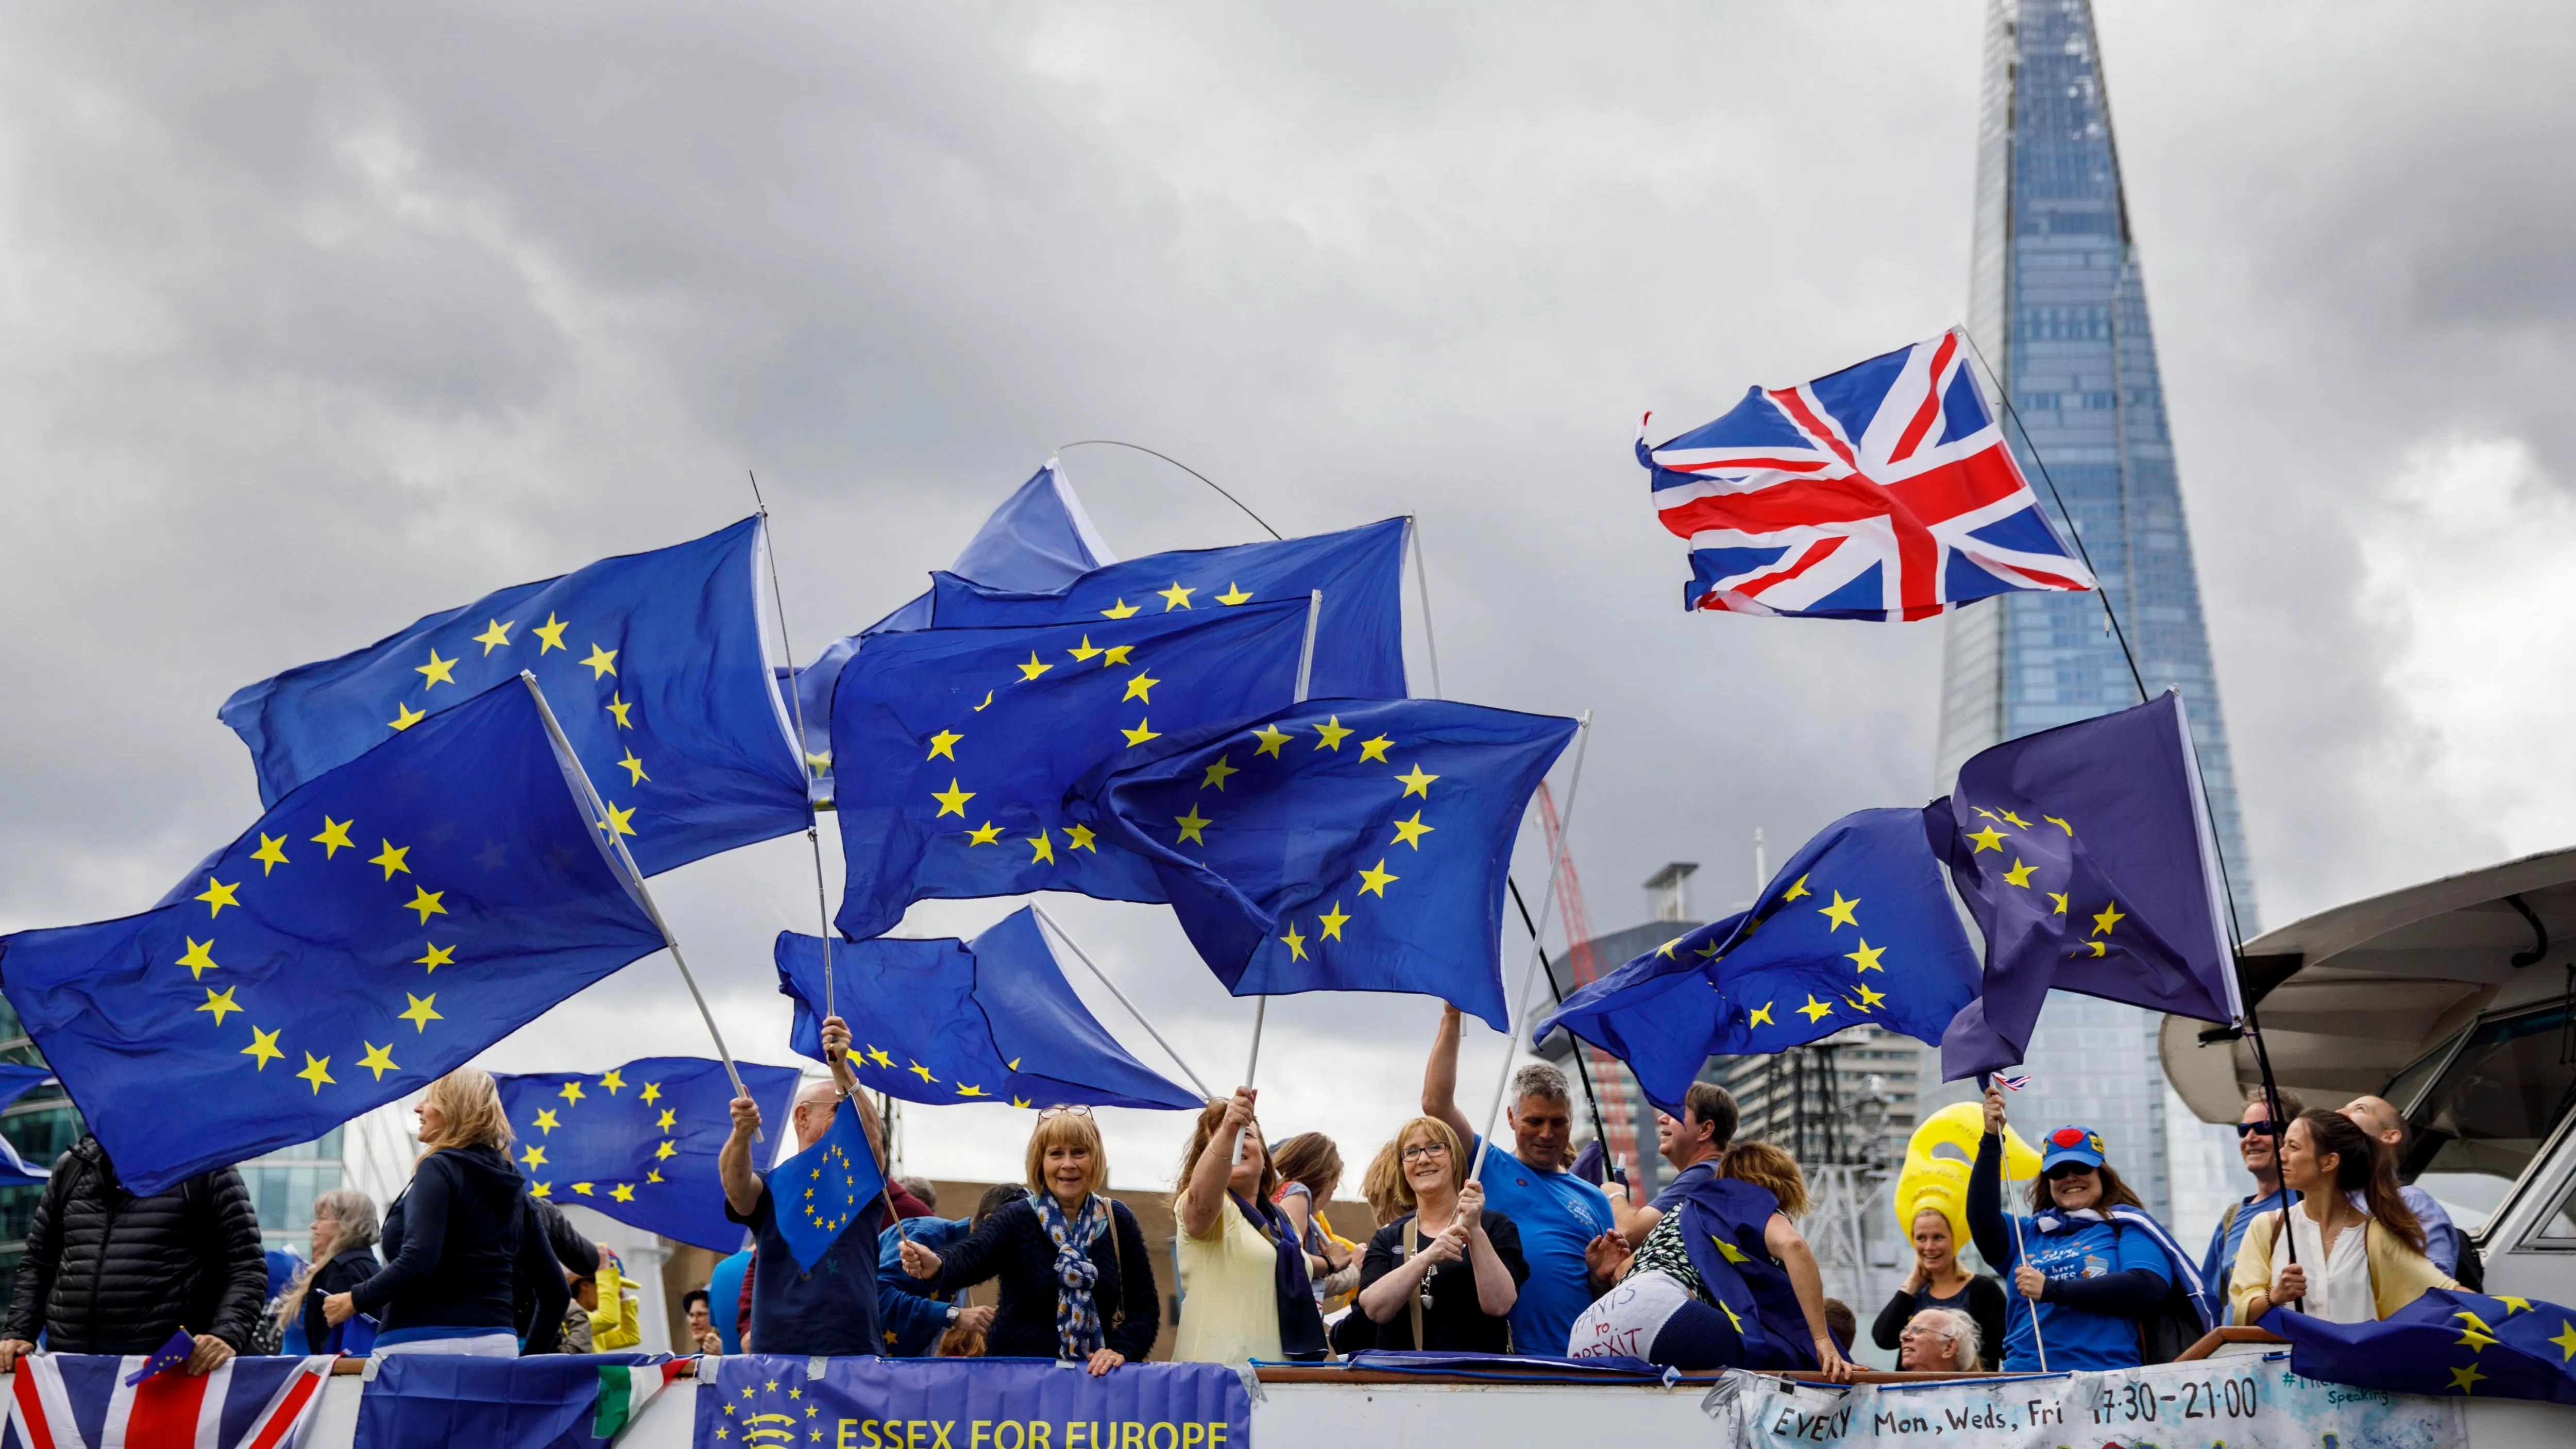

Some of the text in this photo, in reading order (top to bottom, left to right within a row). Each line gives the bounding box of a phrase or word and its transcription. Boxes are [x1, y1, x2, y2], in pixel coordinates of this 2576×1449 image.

[2052, 1264, 2075, 1273] have
[1574, 1284, 1636, 1334] PANTS
[2327, 1390, 2388, 1410] Speaking
[837, 1419, 1228, 1449] ESSEX FOR EUROPE
[1773, 1405, 1852, 1441] EVERY
[1945, 1403, 2018, 1432] Weds,
[2028, 1399, 2063, 1426] Fri
